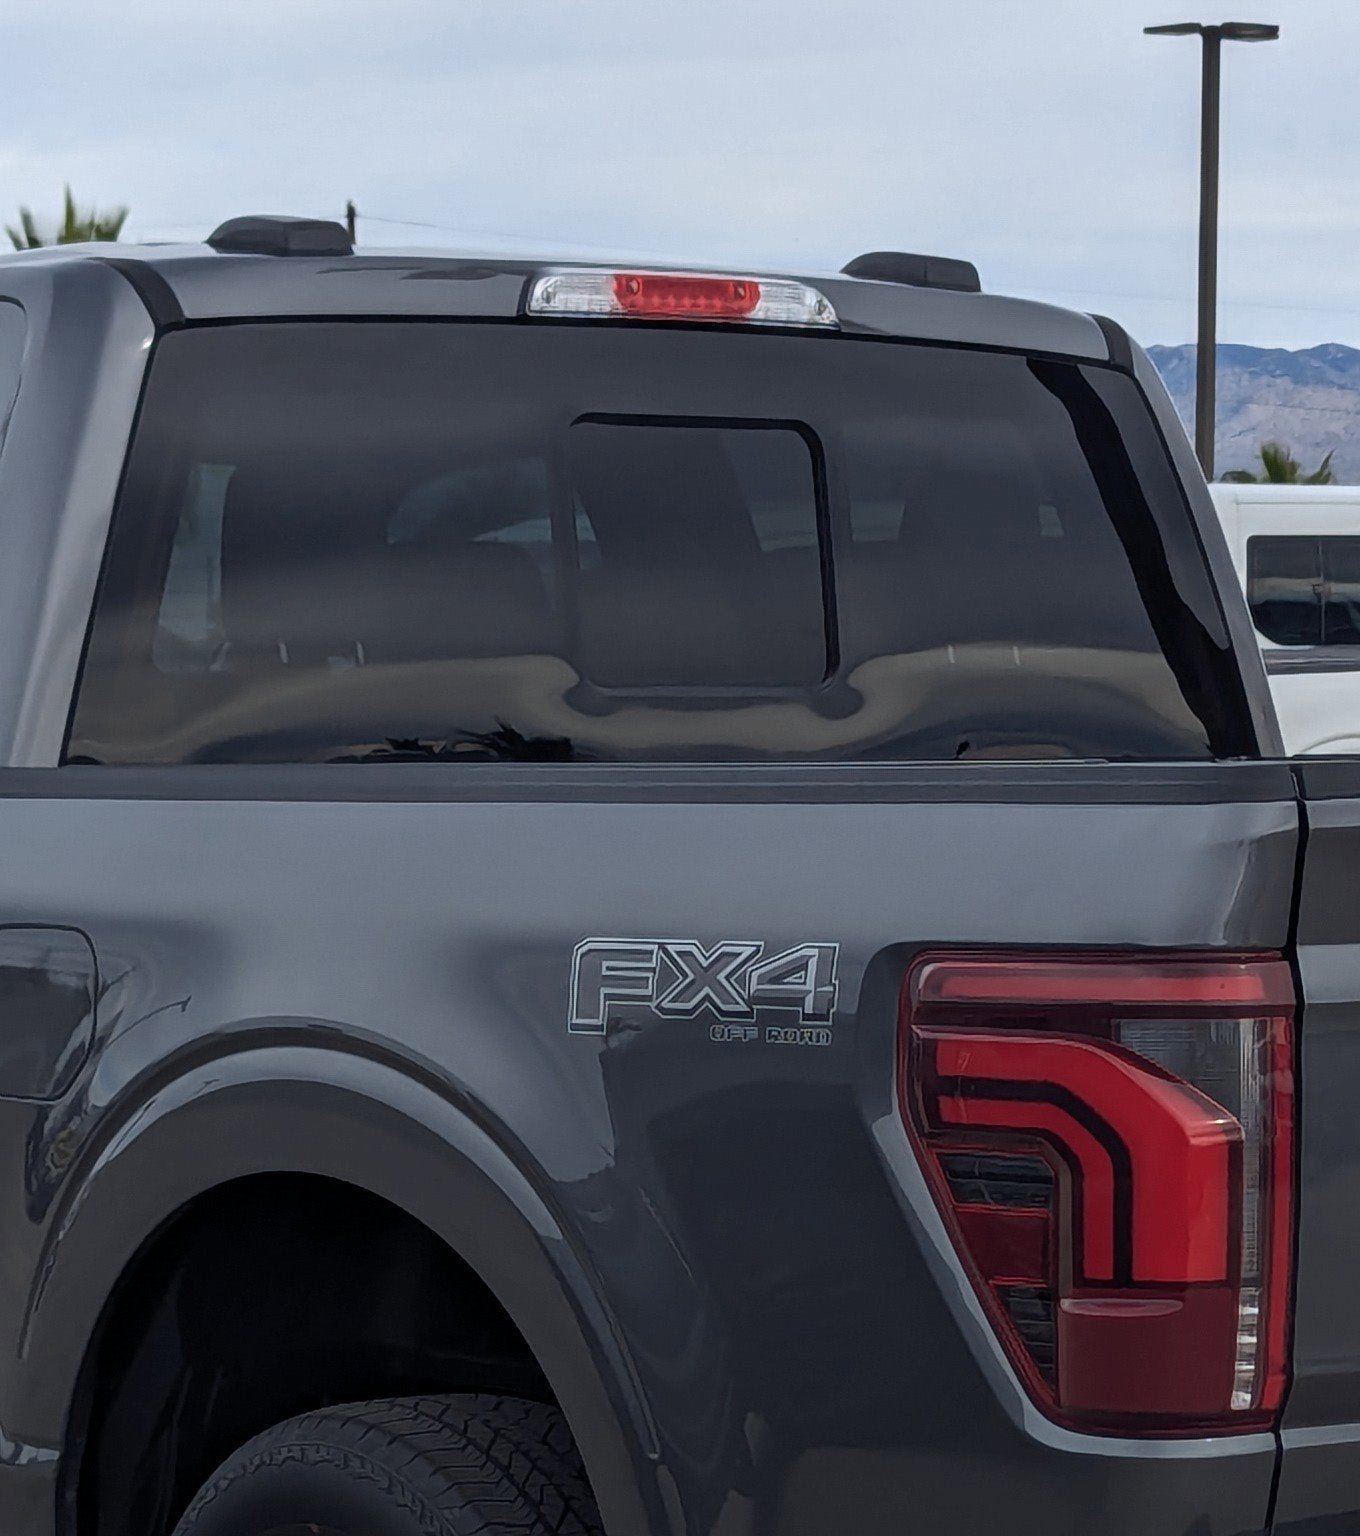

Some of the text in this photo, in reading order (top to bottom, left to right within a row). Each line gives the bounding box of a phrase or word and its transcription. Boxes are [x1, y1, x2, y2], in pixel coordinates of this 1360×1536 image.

[568, 937, 839, 1035] FX4
[709, 1024, 833, 1046] OFF ROAD
